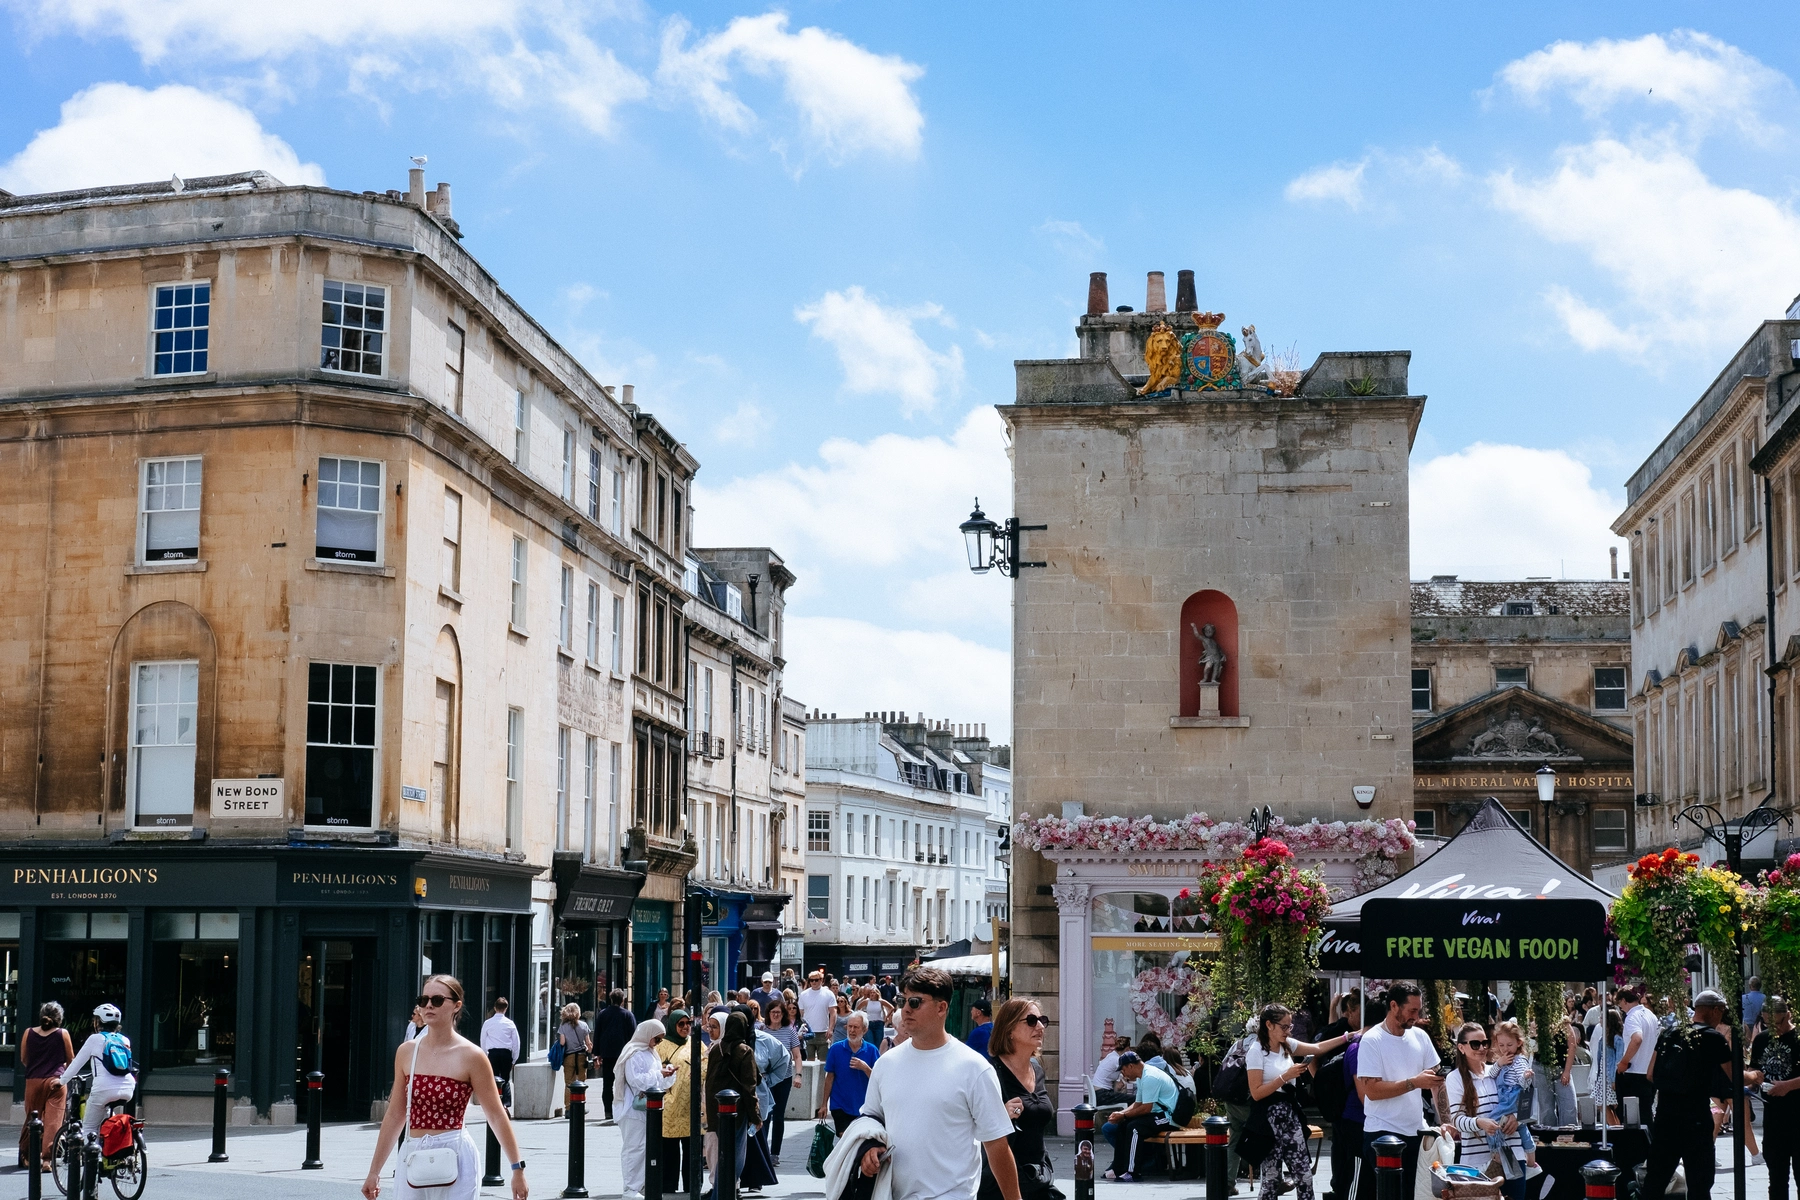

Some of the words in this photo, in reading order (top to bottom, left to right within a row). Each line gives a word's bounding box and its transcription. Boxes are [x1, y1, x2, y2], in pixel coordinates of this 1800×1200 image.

[163, 551, 184, 559] storm
[335, 550, 357, 559] storm
[1441, 777, 1507, 787] MINERAL
[1512, 777, 1561, 787] WATR
[1568, 777, 1633, 787] HOSPITA
[217, 786, 242, 797] NEW
[245, 786, 278, 797] BOND
[223, 799, 269, 810] STREET
[156, 816, 177, 825] storm
[326, 816, 349, 825] storm
[13, 868, 158, 884] PENHALIGON'S
[1127, 864, 1179, 877] SWEET
[292, 872, 398, 886] PENHALIGON'S
[1397, 873, 1562, 899] Viva!
[573, 896, 597, 911] FRENCH
[597, 898, 615, 913] GREY
[1462, 910, 1501, 926] Viva!
[1386, 937, 1435, 958] FREE
[1443, 937, 1511, 959] VEGAN
[1519, 938, 1579, 960] FOOD!
